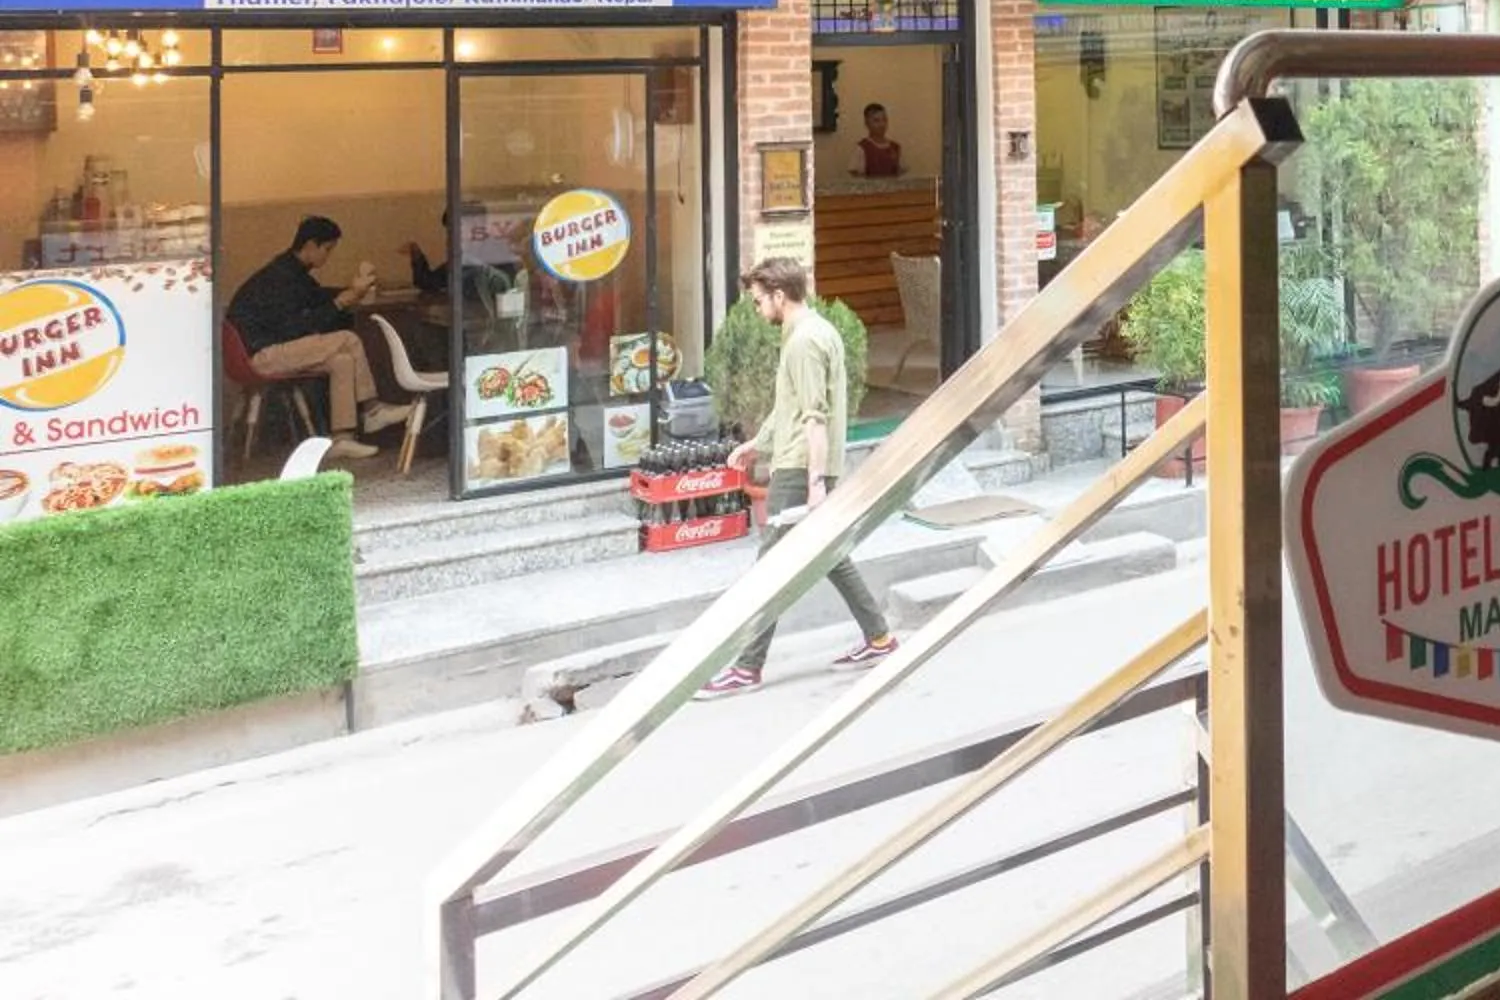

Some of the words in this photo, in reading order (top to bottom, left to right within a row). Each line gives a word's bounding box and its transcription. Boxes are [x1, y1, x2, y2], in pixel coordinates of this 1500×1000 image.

[540, 208, 618, 247] BURGER
[566, 232, 605, 258] INN
[0, 306, 104, 357] URGER
[21, 341, 82, 378] INN
[12, 421, 36, 446] &
[47, 402, 201, 443] Sandwich
